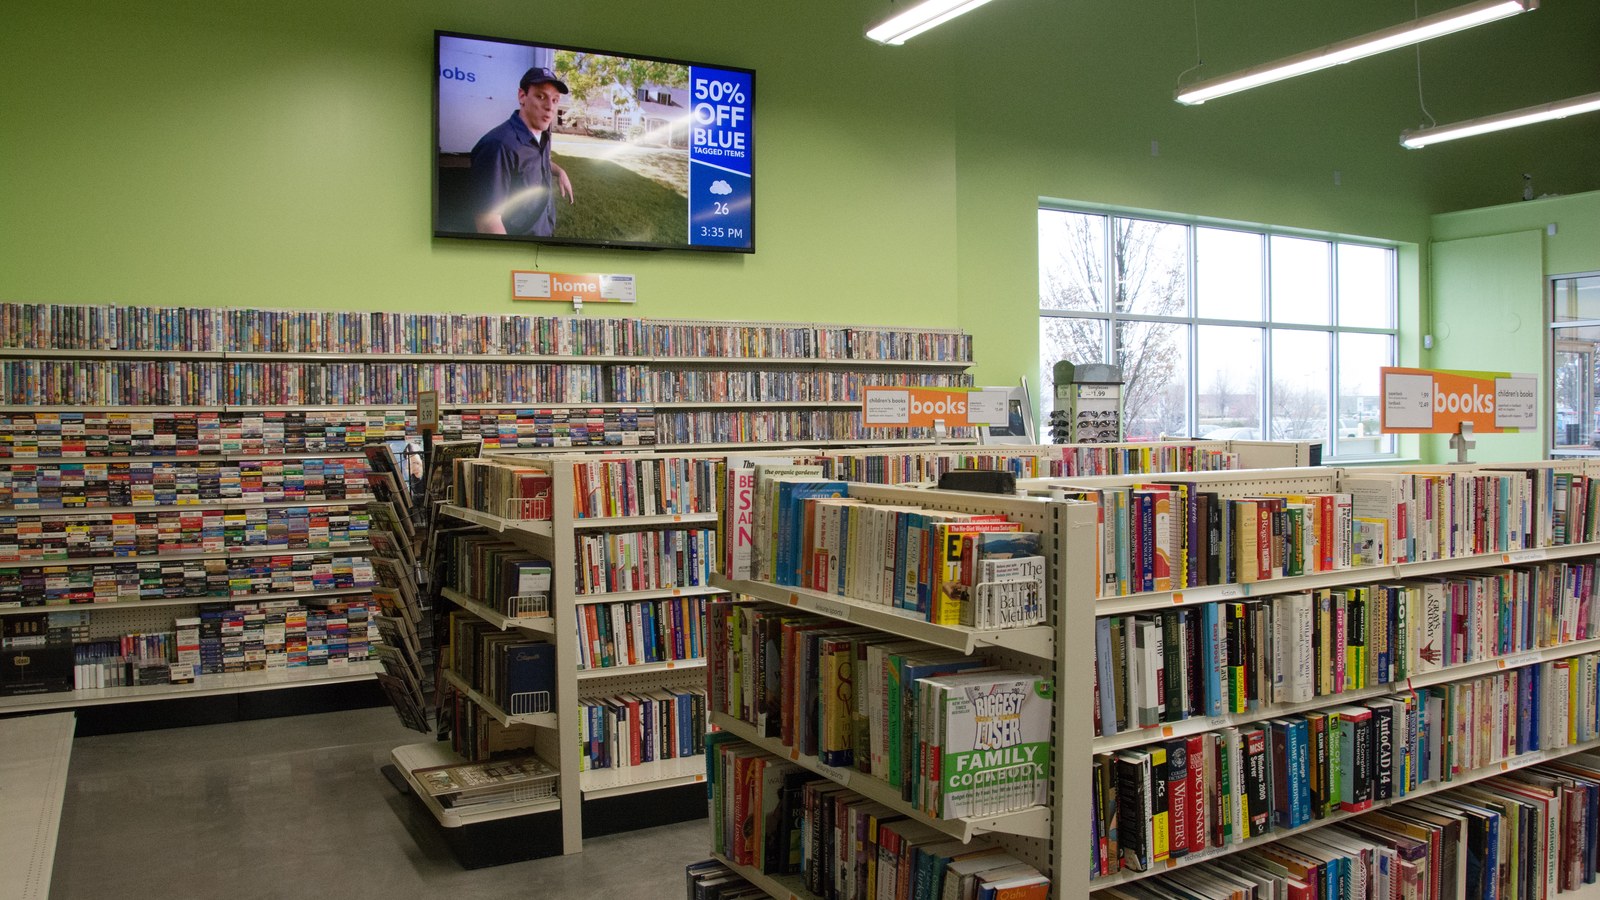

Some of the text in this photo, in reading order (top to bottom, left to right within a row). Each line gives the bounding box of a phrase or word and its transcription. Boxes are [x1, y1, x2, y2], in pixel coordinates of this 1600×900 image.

[439, 64, 476, 83] obs
[694, 78, 746, 104] 50%
[694, 102, 745, 127] OFF
[694, 127, 745, 150] BLUE
[694, 146, 745, 158] TAGGED ITEMS
[714, 202, 729, 215] 26
[701, 226, 743, 239] 3:35 PM
[553, 277, 597, 292] home
[1434, 382, 1494, 414] books
[1498, 390, 1534, 398] children's books
[910, 395, 966, 415] books
[743, 460, 755, 469] The
[740, 475, 755, 488] BE
[1020, 561, 1042, 577] The
[1433, 599, 1441, 630] GRAY'S
[1220, 665, 1228, 681] Last
[975, 692, 1026, 718] BIGGEST
[974, 716, 1022, 751] LOSER
[1249, 741, 1264, 754] MCSE
[1380, 715, 1391, 783] AutoCAD 14
[957, 746, 1038, 772] FAMILY
[1257, 753, 1266, 800] Windows 2000
[1291, 764, 1299, 808] RECORDING
[1174, 781, 1186, 848] WEBSTER'S
[1195, 767, 1204, 844] DICTIONARY
[1000, 890, 1026, 899] Oahu
